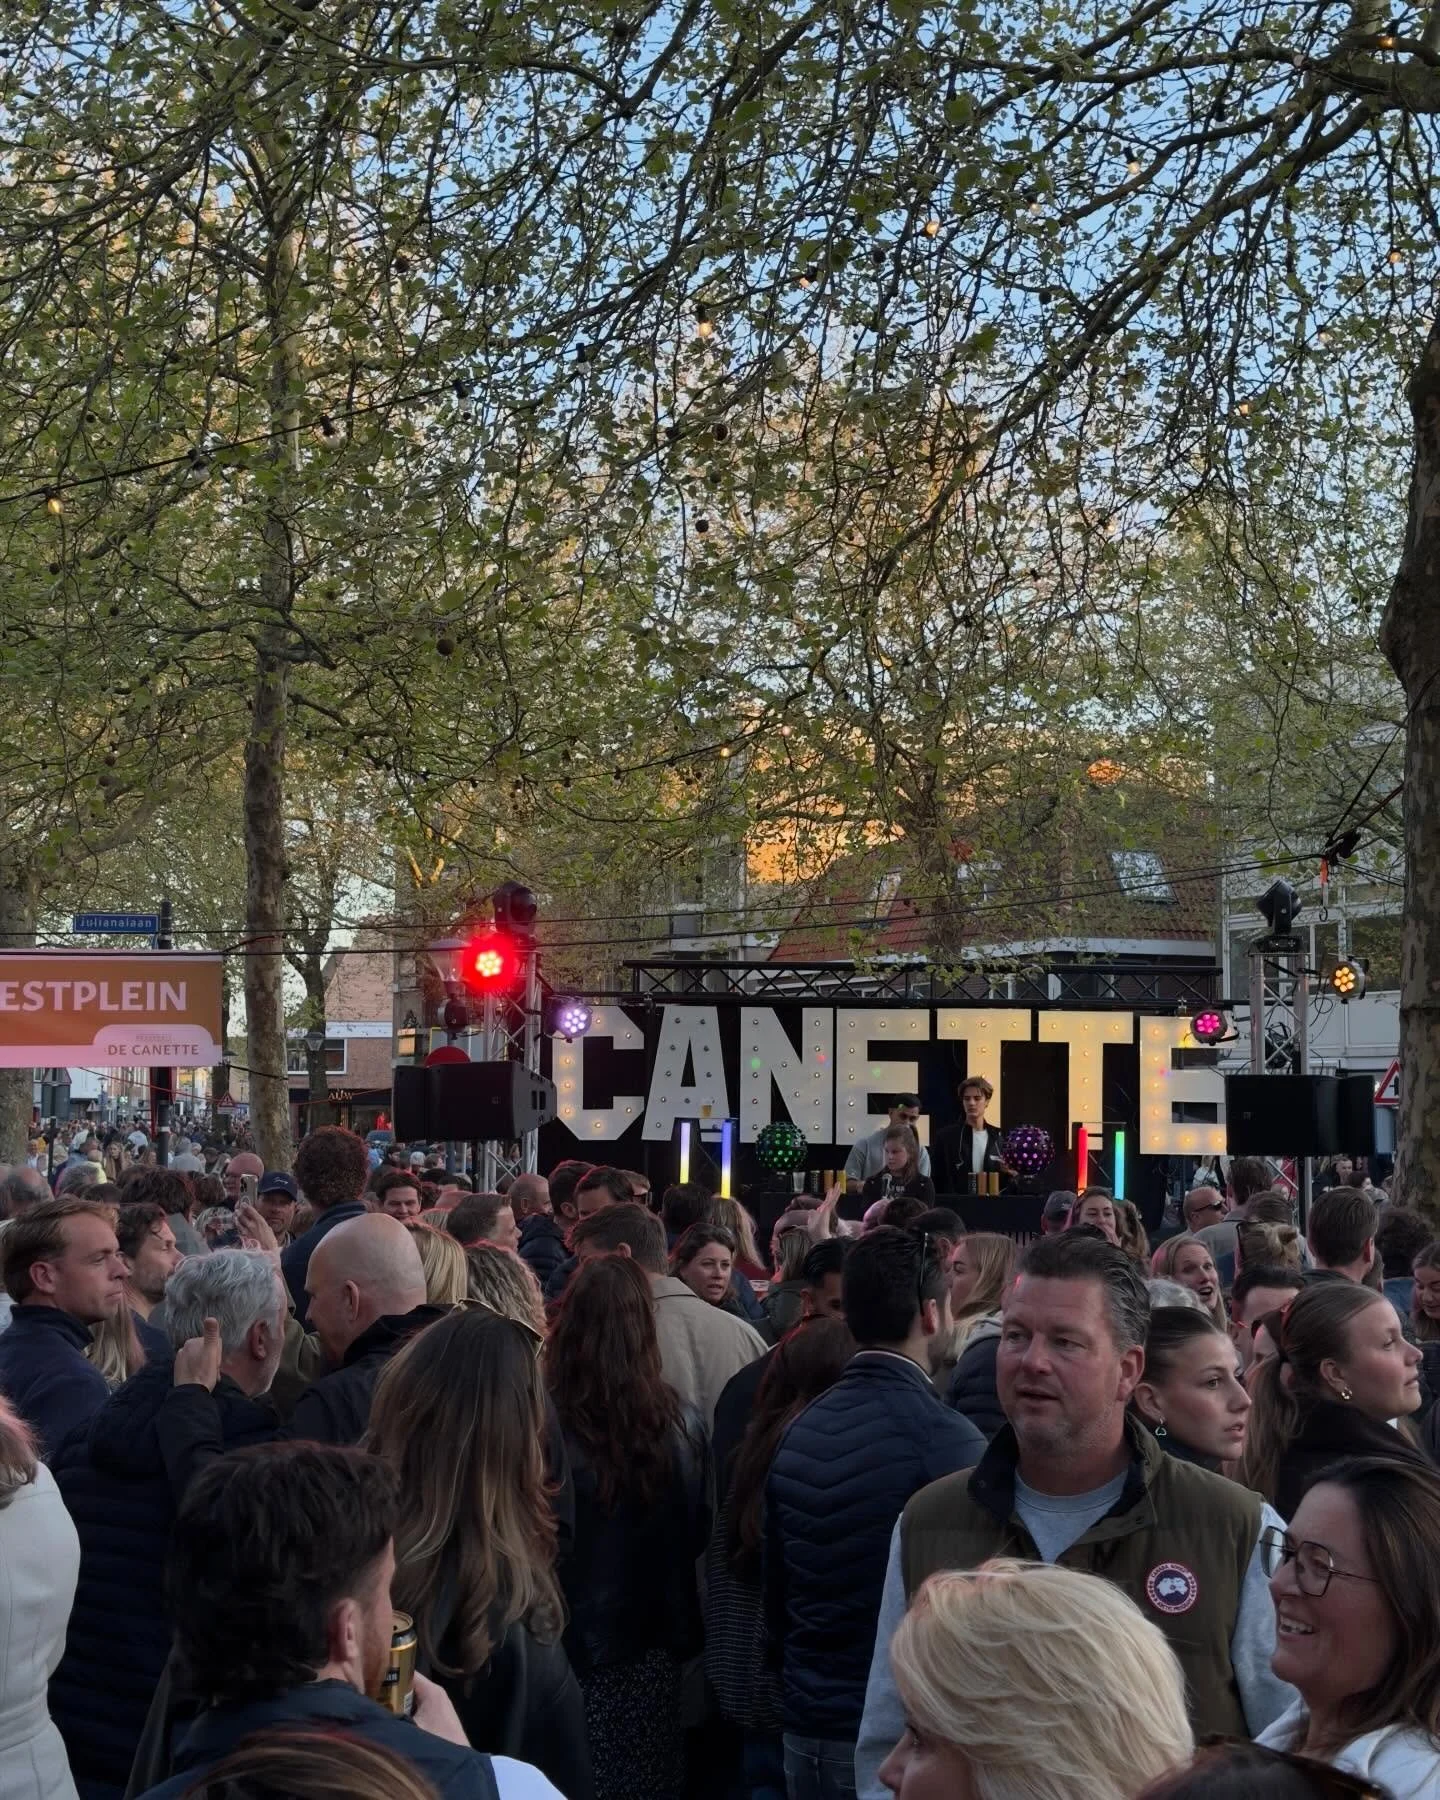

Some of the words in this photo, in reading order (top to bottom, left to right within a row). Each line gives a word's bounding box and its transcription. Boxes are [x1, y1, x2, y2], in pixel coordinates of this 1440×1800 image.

[0, 980, 188, 1012] ESTPLEIN
[107, 1044, 127, 1056] DE
[131, 1044, 200, 1056] CANETTE
[551, 1005, 1238, 1155] CANETTE
